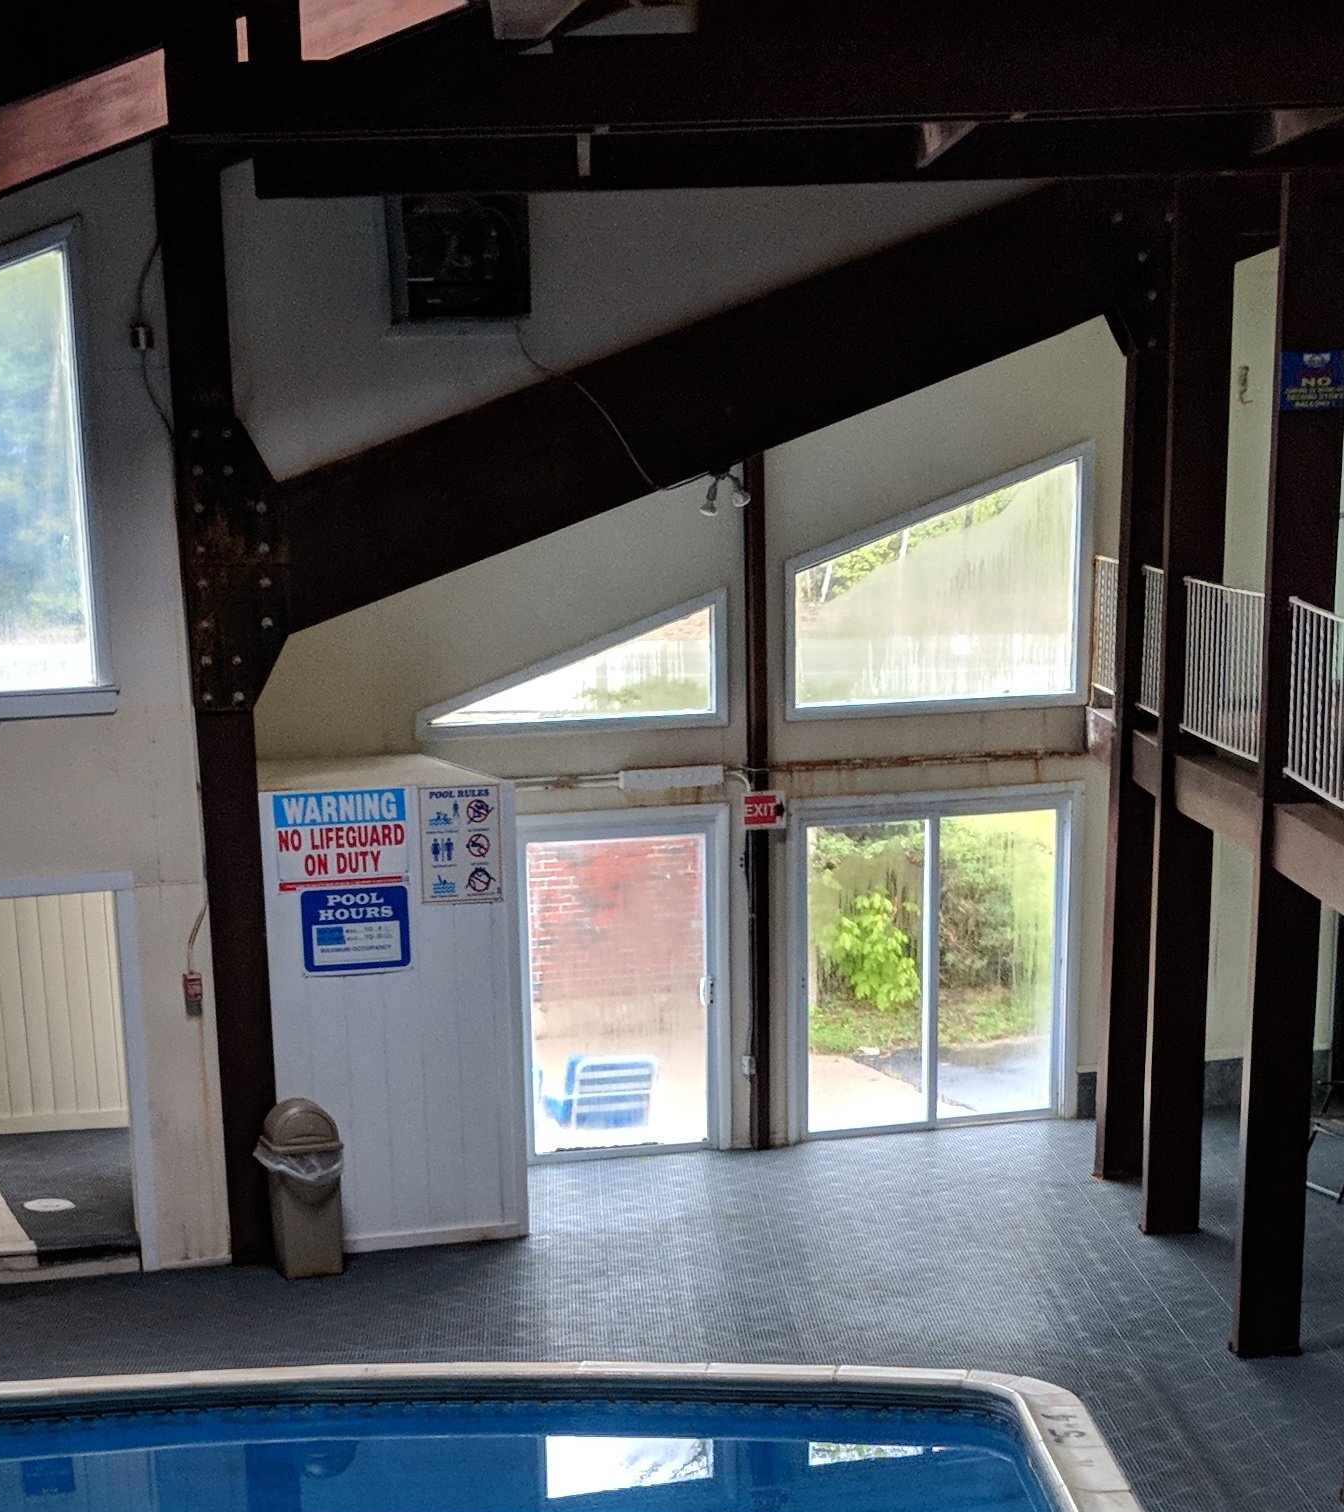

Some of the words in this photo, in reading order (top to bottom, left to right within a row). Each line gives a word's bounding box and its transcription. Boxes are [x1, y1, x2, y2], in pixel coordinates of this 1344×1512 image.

[1301, 377, 1332, 387] NO
[429, 790, 455, 800] POOL
[457, 788, 490, 798] RULES
[283, 792, 397, 824] WARNING
[745, 803, 776, 818] EXIT
[278, 829, 302, 852] NO
[310, 823, 405, 850] LIFEGUARD
[304, 853, 328, 877] ON
[336, 850, 381, 873] DUTY
[326, 892, 385, 907] POOL
[318, 905, 394, 921] HOURS
